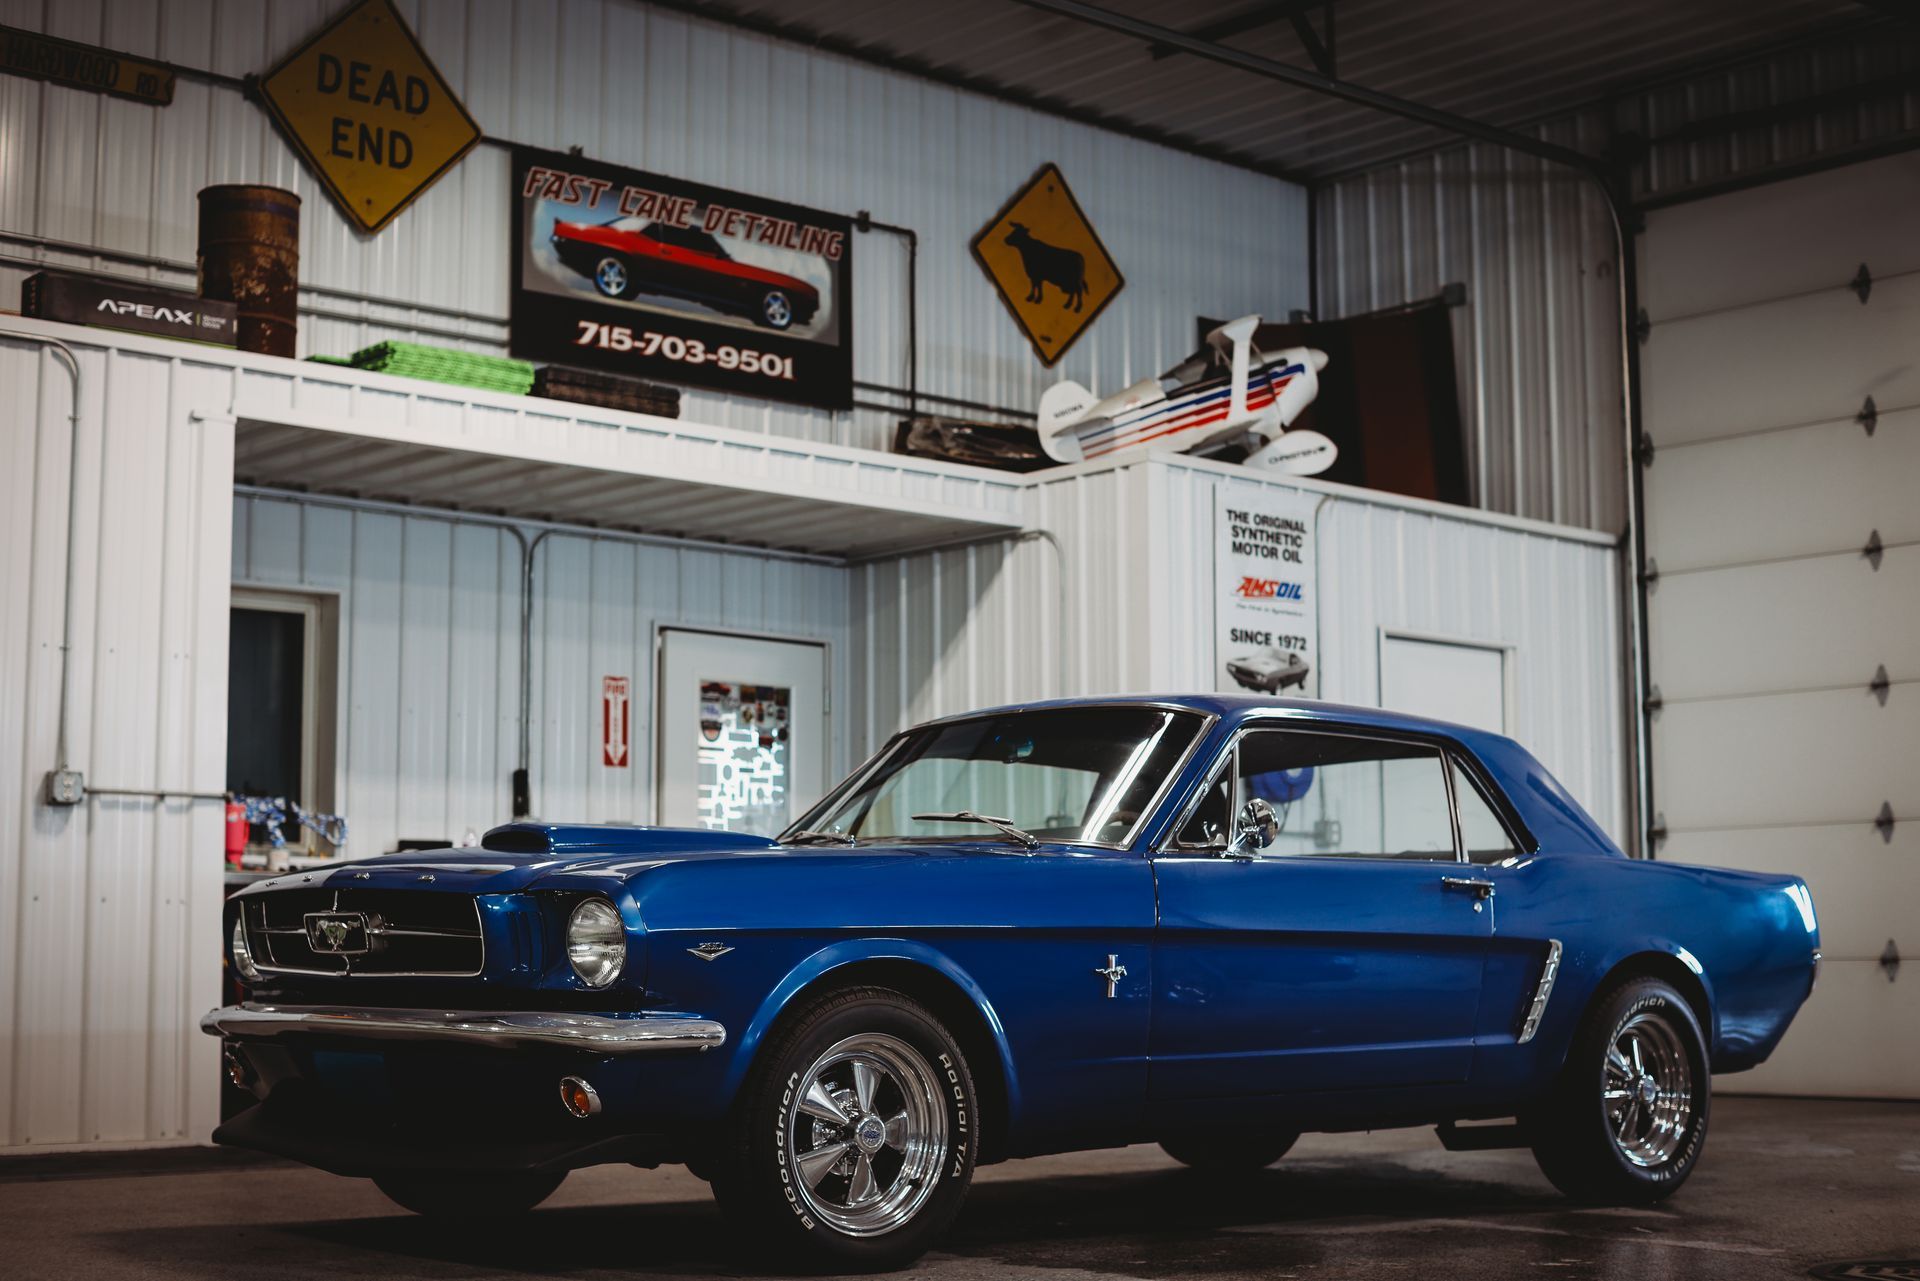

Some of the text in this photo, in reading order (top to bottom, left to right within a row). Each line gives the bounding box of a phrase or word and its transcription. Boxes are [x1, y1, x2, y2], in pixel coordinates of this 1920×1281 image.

[5, 34, 160, 96] HARDWOOD RD
[316, 53, 430, 116] DEAD
[331, 116, 414, 169] END
[523, 166, 844, 260] FAST LANE DETAILING
[97, 298, 193, 327] APEAX
[575, 320, 796, 380] 715-703-9501
[1227, 509, 1307, 534] THE ORIGINAL
[1232, 525, 1303, 548] SYNTHETIC
[1232, 541, 1303, 563] MOTOR OIL
[1236, 576, 1303, 600] AMSOIL
[1230, 628, 1307, 651] SINCE 1972
[938, 1053, 968, 1178] Radial T/A
[775, 1070, 815, 1231] BFGoodrich
